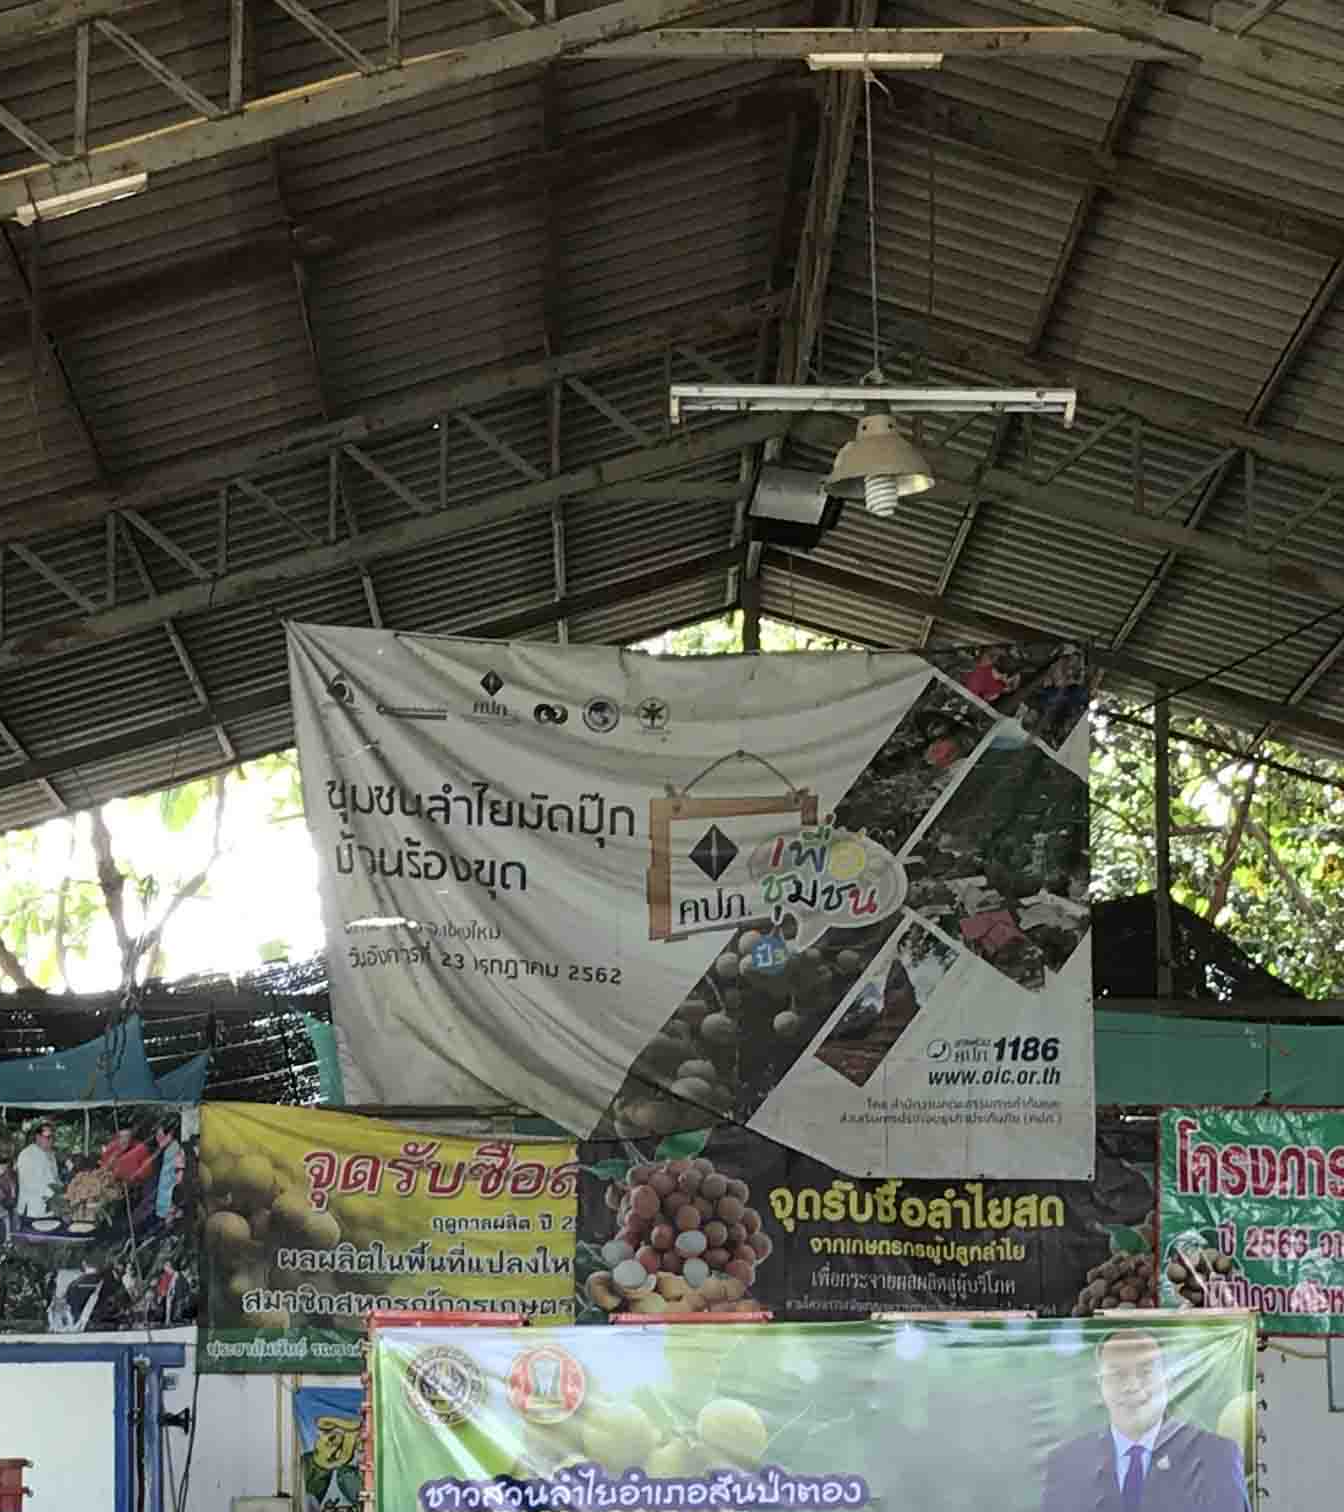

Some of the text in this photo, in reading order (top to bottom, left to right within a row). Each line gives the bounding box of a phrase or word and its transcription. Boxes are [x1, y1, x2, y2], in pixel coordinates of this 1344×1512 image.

[325, 780, 635, 848] ชุมชนลำไยมัดปุ๊ก
[441, 954, 465, 970] 23
[567, 964, 622, 985] 2562
[993, 1035, 1061, 1062] 1186
[927, 1066, 1061, 1086] www.oic.or.th
[768, 1179, 1066, 1233] จุดรับซื้อลำไยสด
[277, 1241, 576, 1275] ผลผลิตในพื้นที่แปลงให
[424, 1467, 862, 1507] ชาวสวนลำไยอำเภอสันป่าตอง
